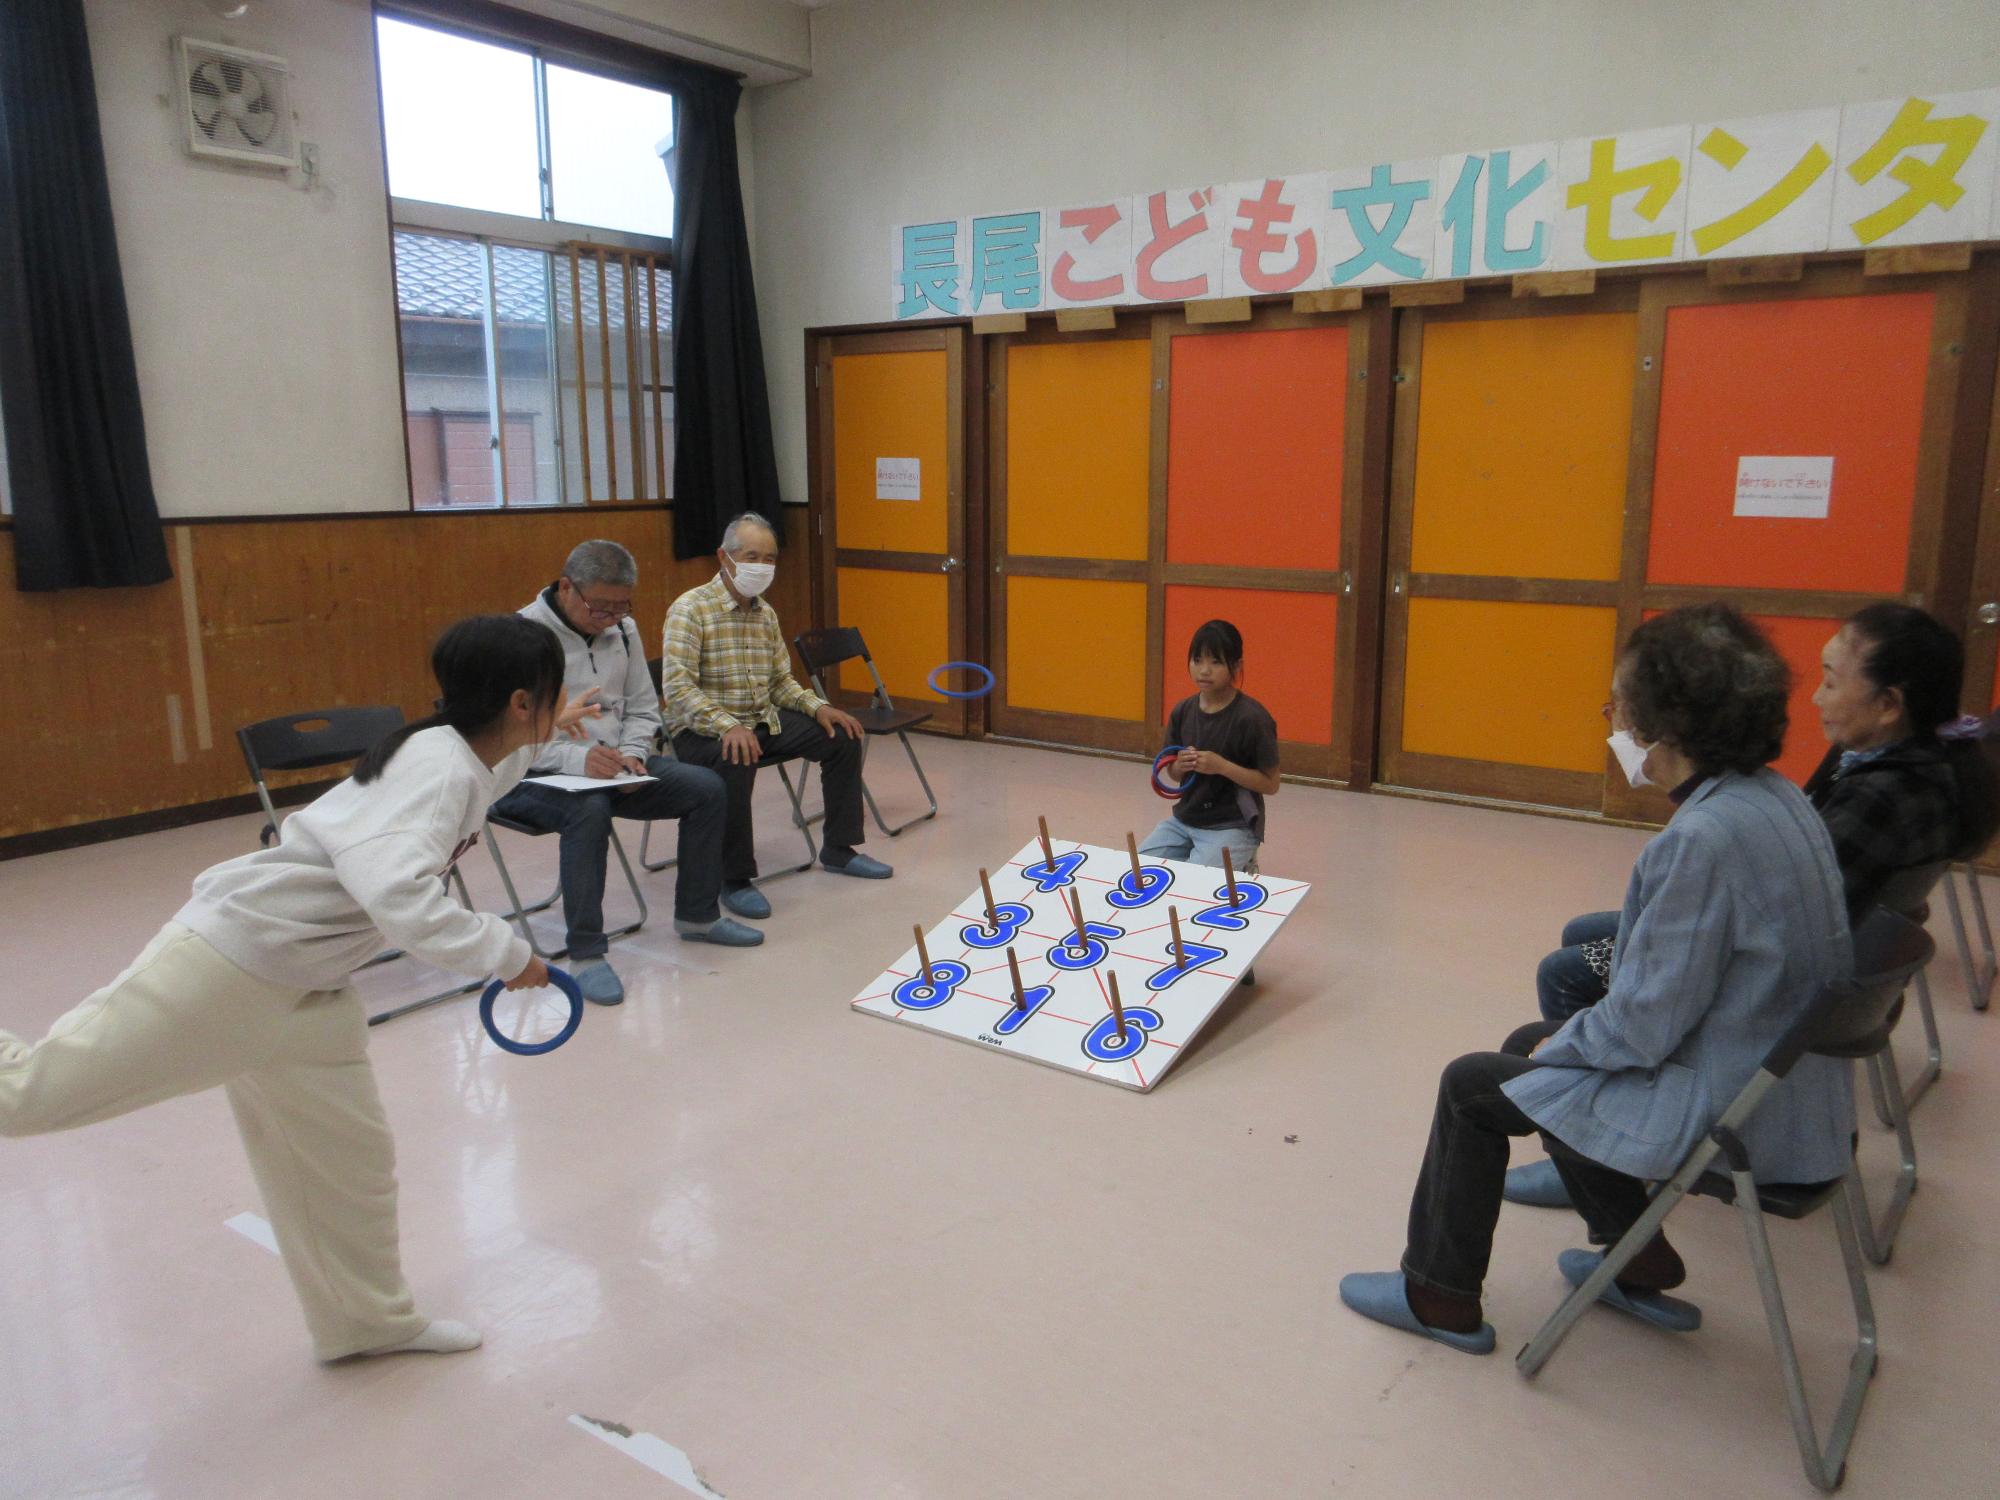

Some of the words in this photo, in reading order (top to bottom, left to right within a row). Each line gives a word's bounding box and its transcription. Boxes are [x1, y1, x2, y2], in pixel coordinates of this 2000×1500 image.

[1020, 851, 1089, 893] 4
[1105, 865, 1176, 909] 9
[1191, 881, 1269, 930] 2
[960, 902, 1034, 949] 3
[1046, 921, 1126, 970] 5
[1145, 941, 1228, 991] 7
[891, 959, 971, 1011] 8
[993, 984, 1056, 1036] 1
[1081, 1005, 1164, 1063] 6
